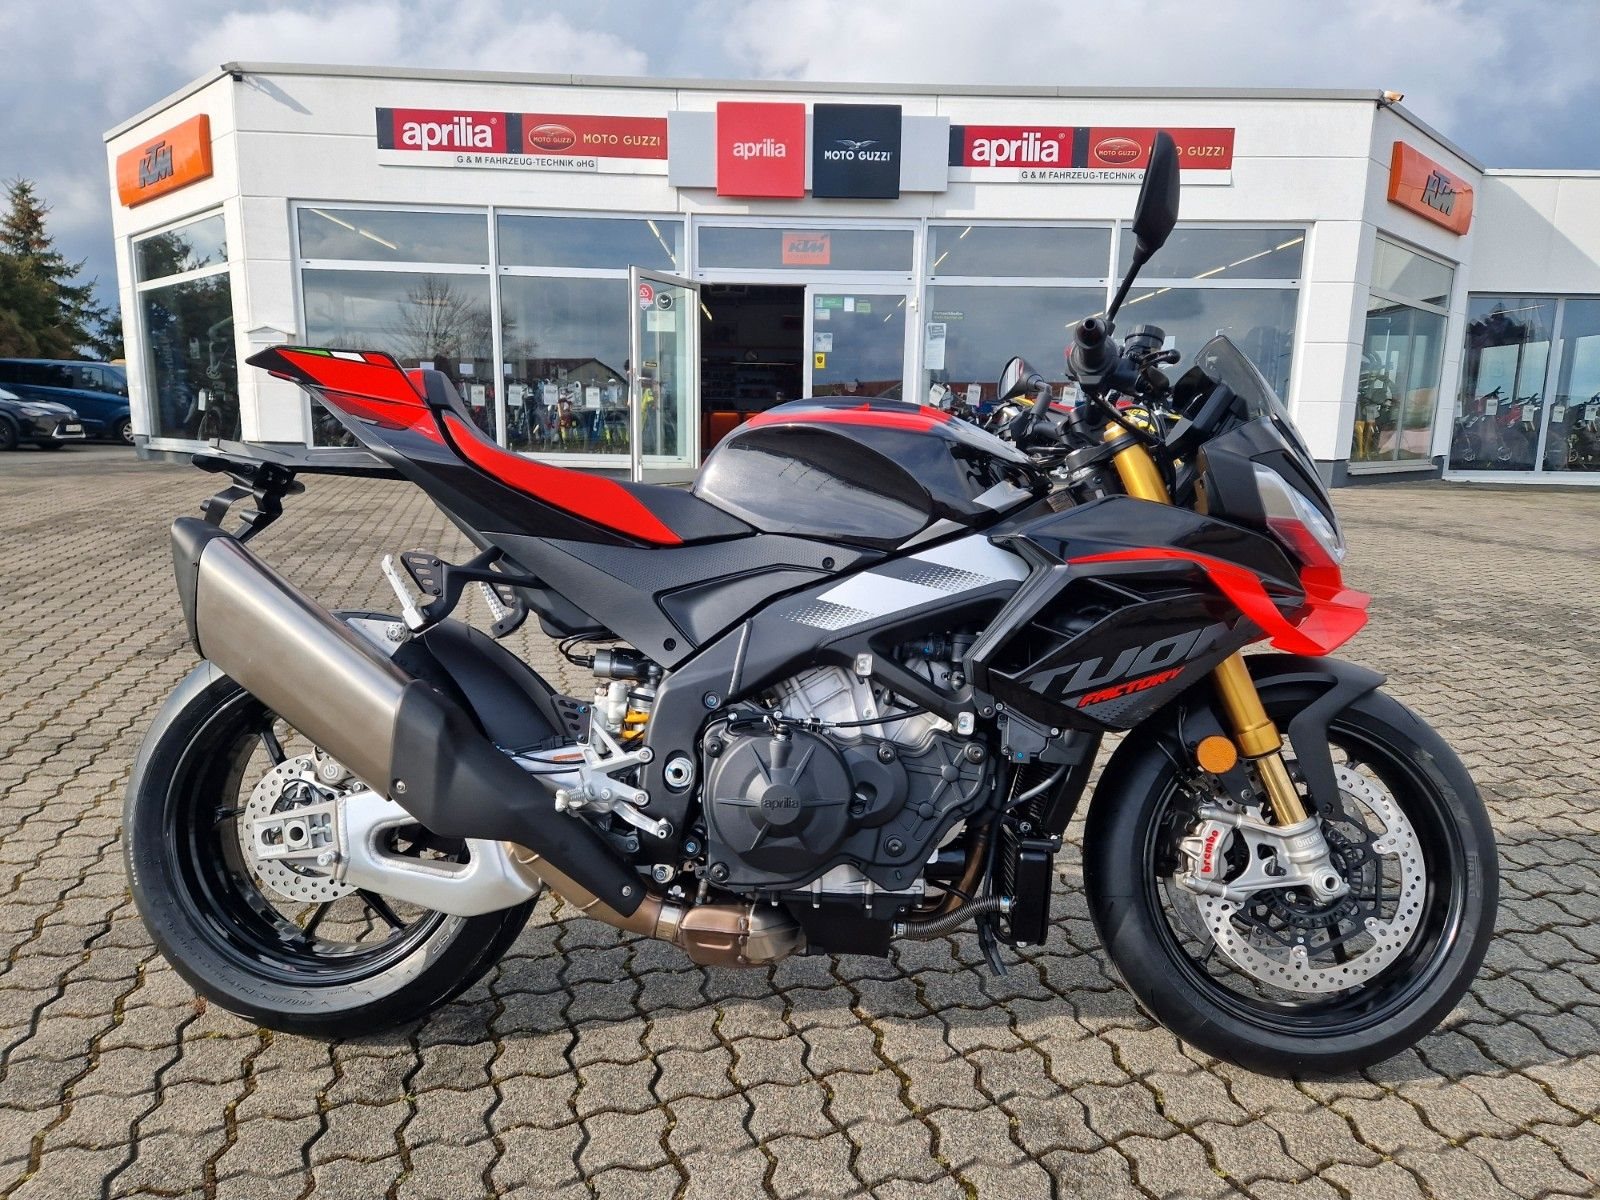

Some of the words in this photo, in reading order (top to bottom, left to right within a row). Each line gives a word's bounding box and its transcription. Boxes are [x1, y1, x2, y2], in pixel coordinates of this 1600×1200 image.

[402, 116, 493, 151] aprilia
[583, 133, 618, 144] MOTO
[623, 135, 661, 146] GUZZI
[733, 139, 786, 160] aprilia
[824, 150, 855, 161] MOTO
[858, 151, 891, 162] GUZZI
[971, 132, 1059, 167] aprilia
[1187, 146, 1225, 157] GUZZI
[139, 140, 174, 189] KTM
[456, 155, 464, 164] G
[466, 156, 473, 164] &
[475, 156, 482, 164] M
[484, 156, 574, 167] FAHRZEUG-TECHNIK
[576, 160, 595, 168] oHG
[1021, 171, 1028, 179] G
[1030, 171, 1037, 179] &
[1039, 171, 1046, 179] M
[1048, 171, 1136, 180] FAHRZEUG-TECHNIK
[1420, 170, 1457, 217] KTM
[787, 240, 825, 253] KTM
[1077, 665, 1186, 708] FACTORY
[763, 796, 799, 811] aprilia
[1201, 829, 1219, 873] brembo
